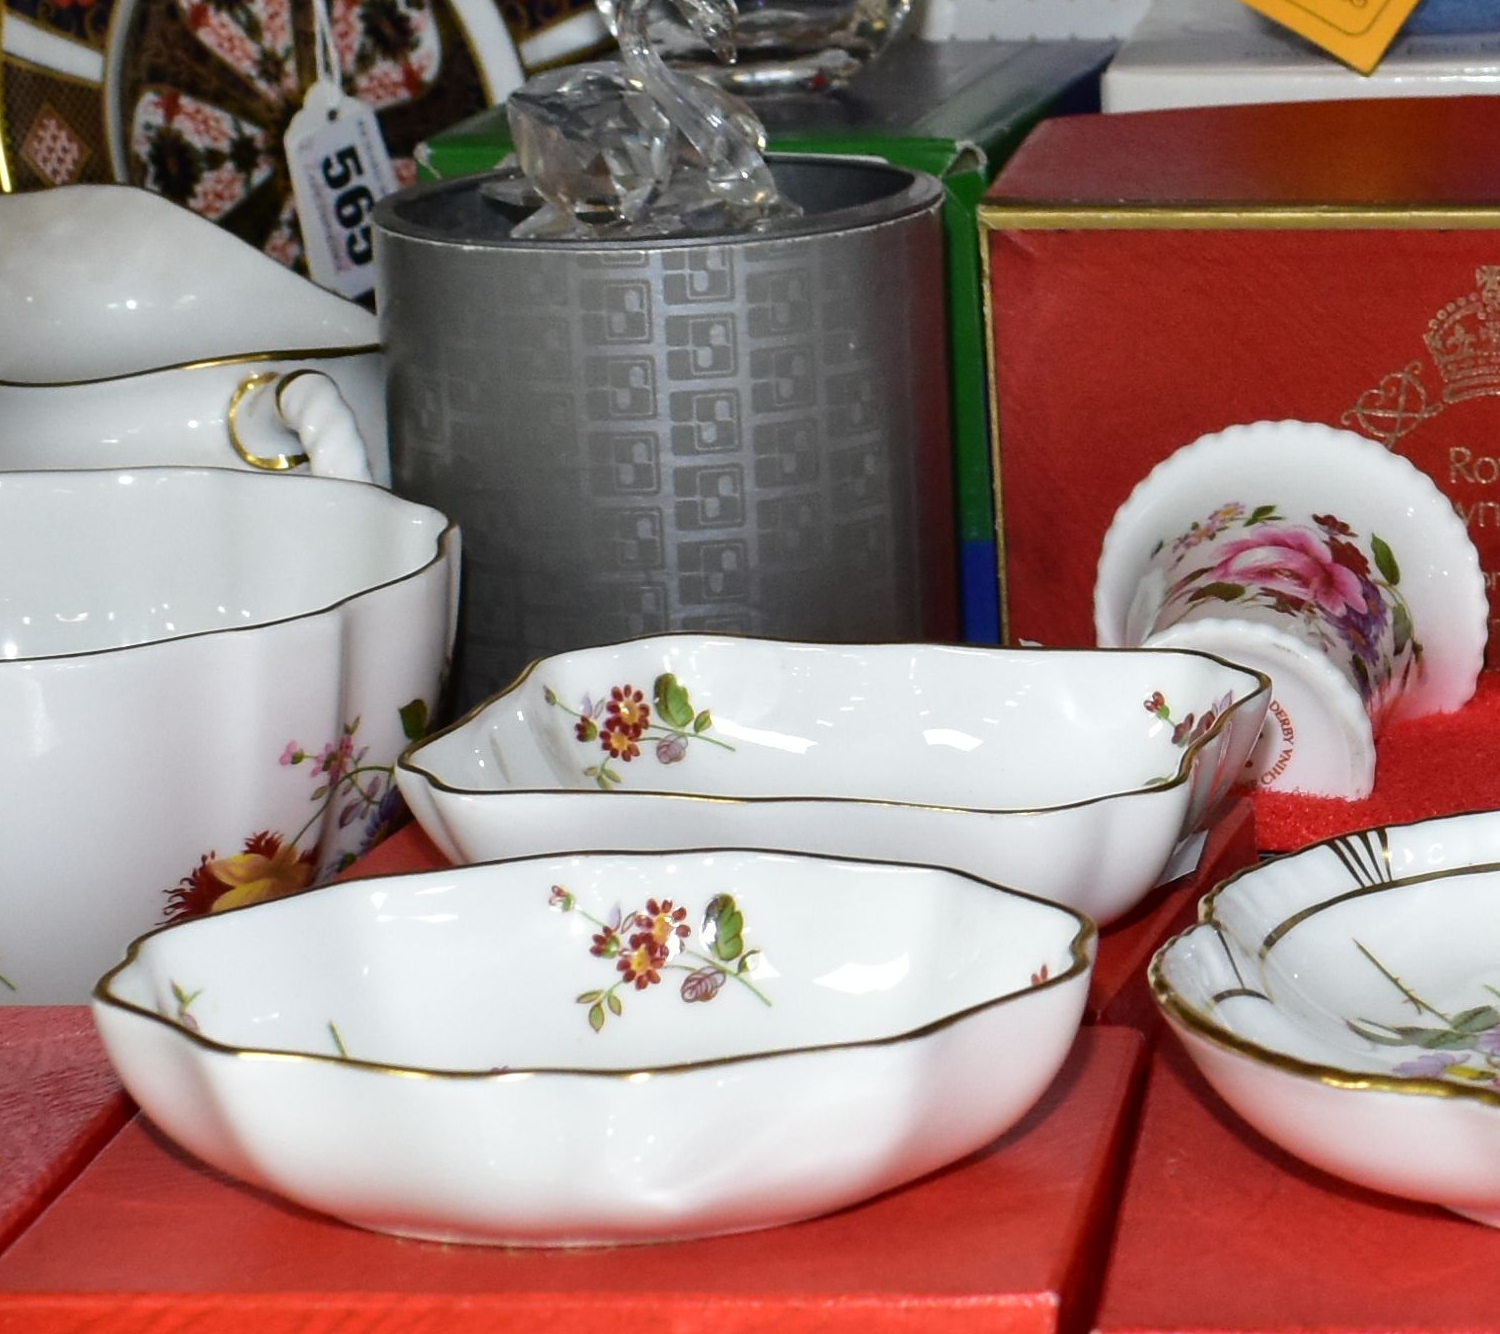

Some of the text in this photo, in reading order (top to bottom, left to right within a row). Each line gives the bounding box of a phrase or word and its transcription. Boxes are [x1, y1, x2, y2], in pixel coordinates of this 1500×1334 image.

[321, 144, 376, 267] 565
[1269, 699, 1295, 745] DERBY
[1261, 748, 1293, 785] CHINA
